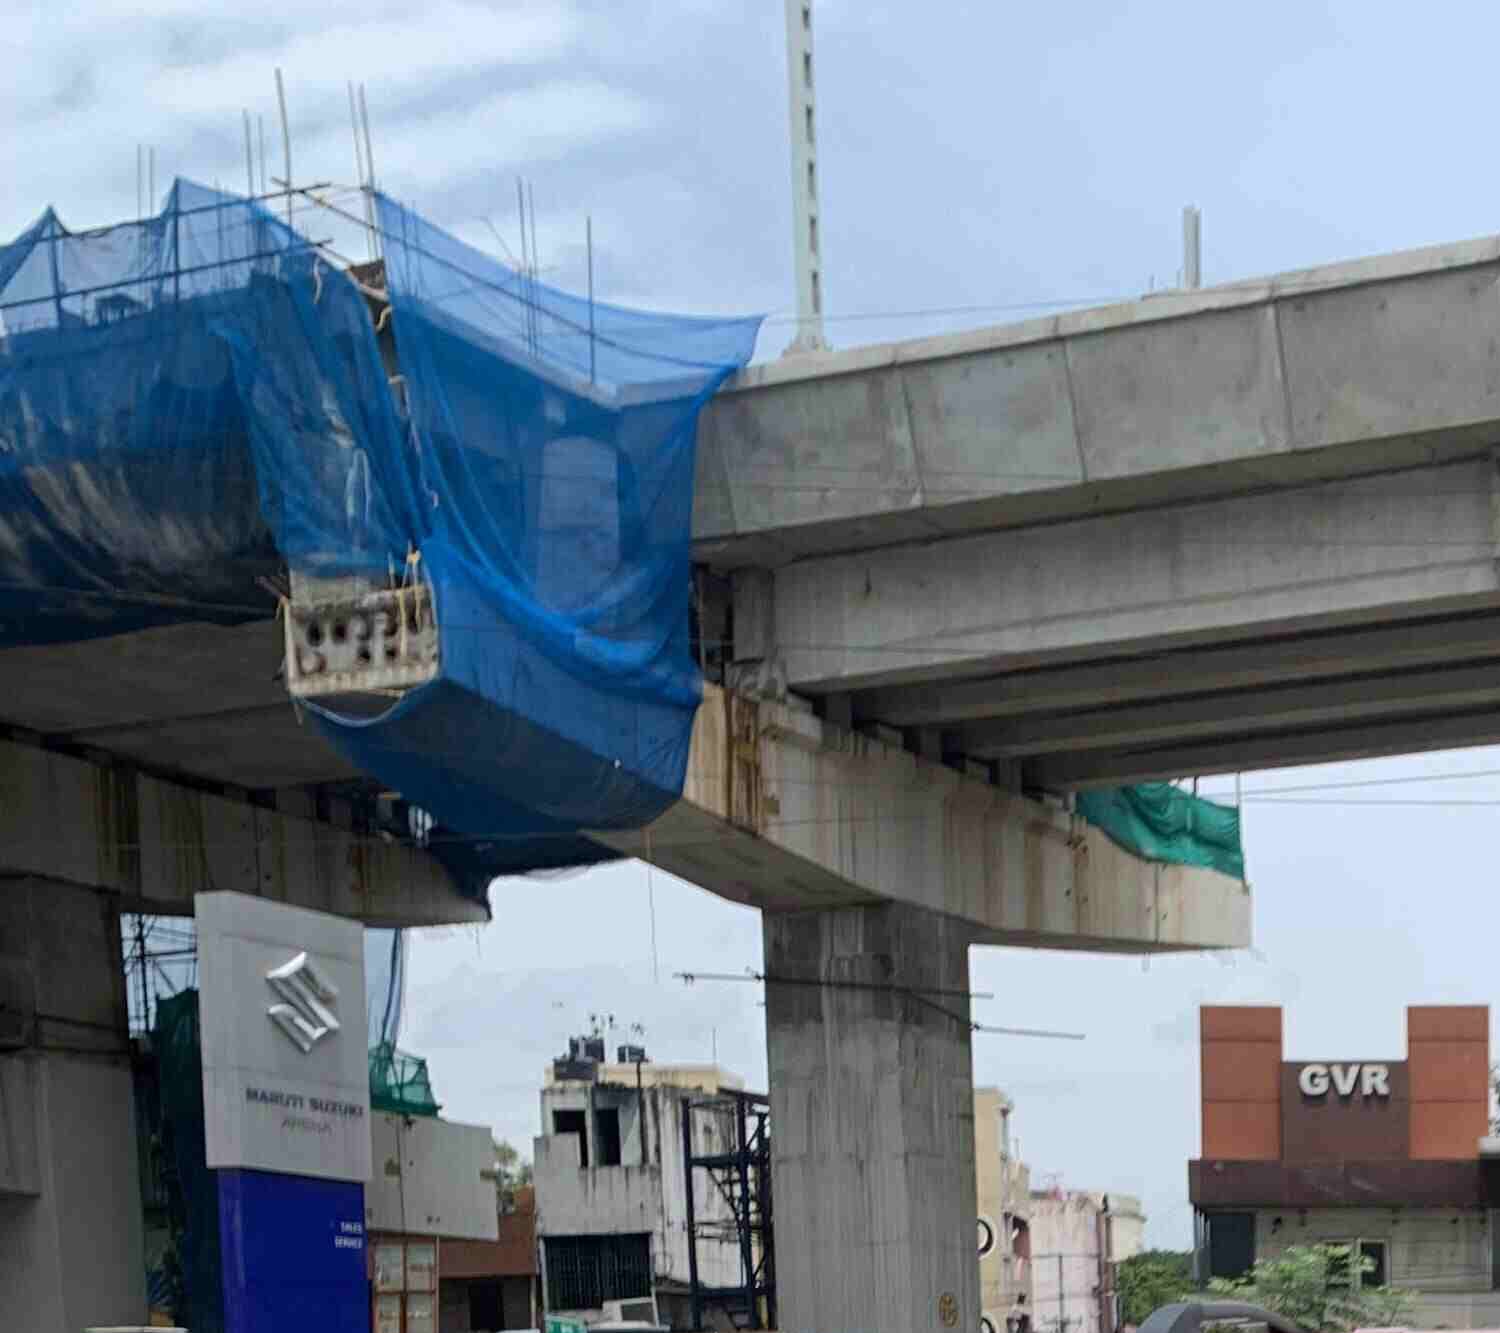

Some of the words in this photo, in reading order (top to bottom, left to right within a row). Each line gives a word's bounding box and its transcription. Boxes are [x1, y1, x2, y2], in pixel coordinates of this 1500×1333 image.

[1298, 1063, 1391, 1097] GVR
[245, 1087, 304, 1110] MARUTI
[308, 1096, 364, 1118] SUZUKI
